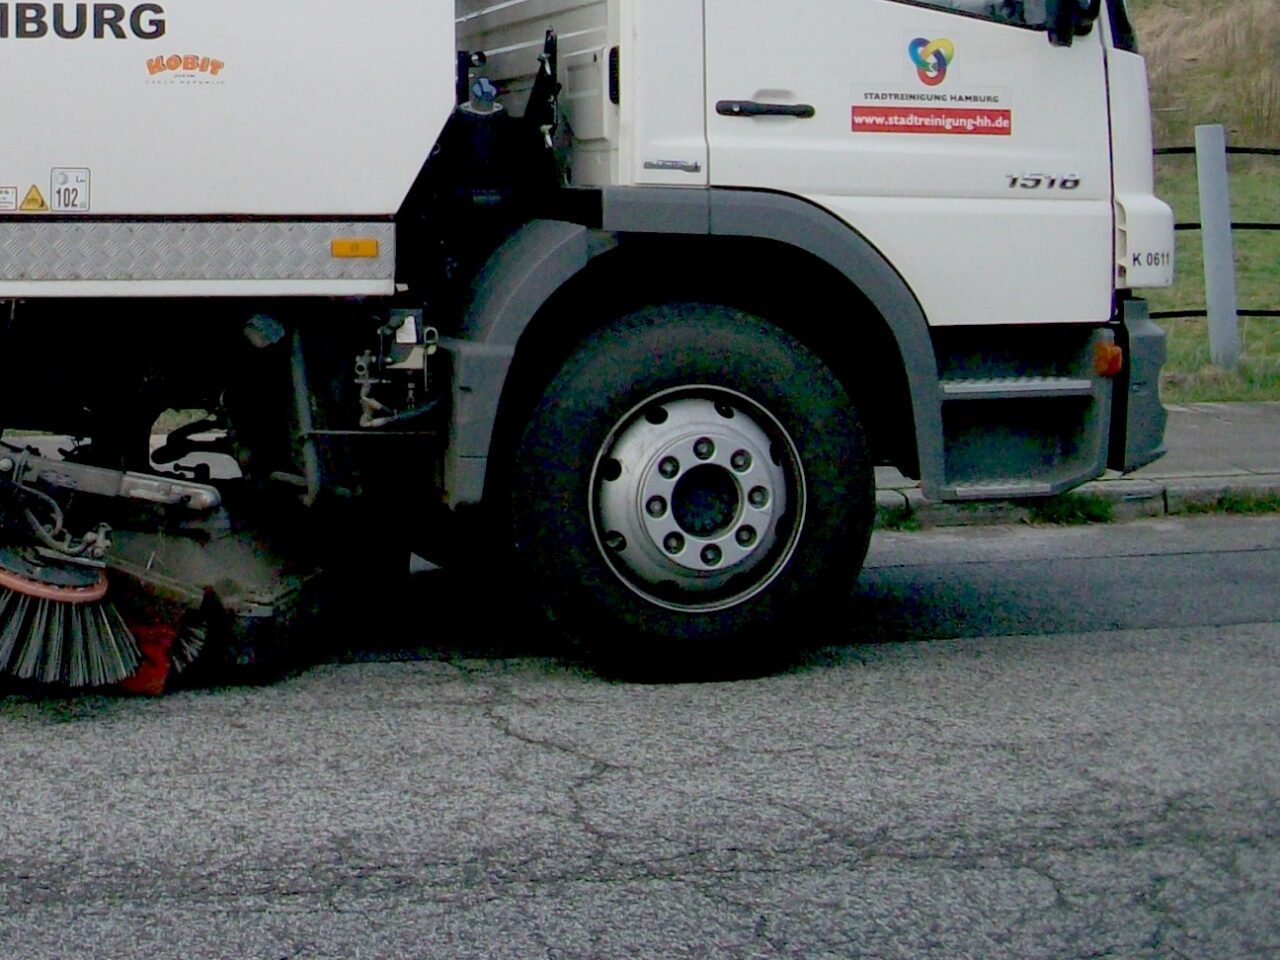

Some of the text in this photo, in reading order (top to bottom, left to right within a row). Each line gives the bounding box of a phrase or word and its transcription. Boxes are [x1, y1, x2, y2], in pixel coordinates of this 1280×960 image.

[146, 53, 225, 76] KOBIT
[864, 92, 1000, 103] STADTREINIGUNG HAMBURG
[853, 113, 1010, 130] www.stadtreinigung-hh.de
[56, 187, 79, 208] 102
[1132, 252, 1170, 266] K 0611
